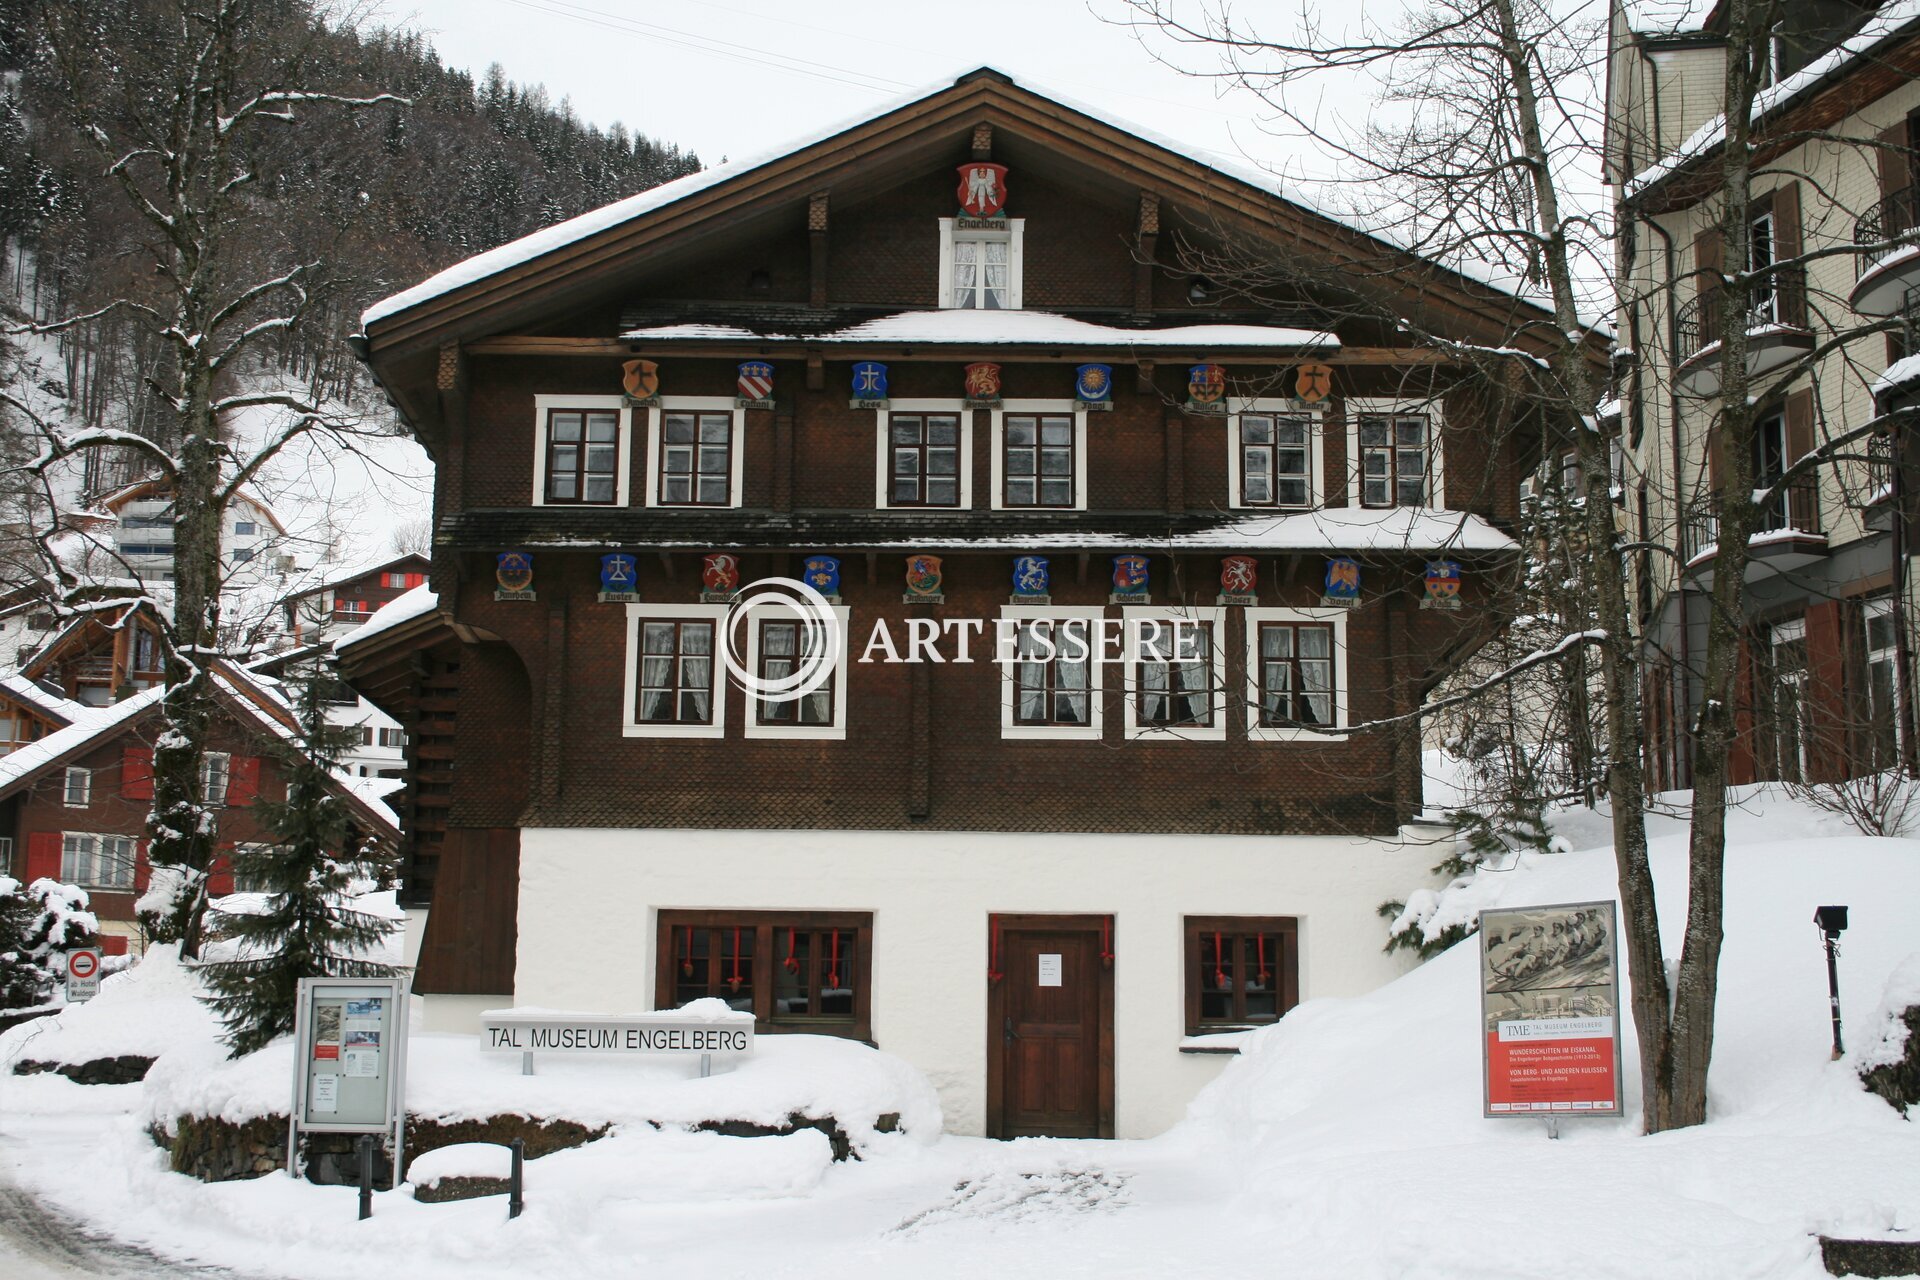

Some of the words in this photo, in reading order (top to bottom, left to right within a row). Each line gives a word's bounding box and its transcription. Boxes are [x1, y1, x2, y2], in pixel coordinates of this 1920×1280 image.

[958, 218, 1005, 229] Engelberg
[858, 400, 881, 409] Hess
[1506, 1025, 1530, 1036] TME
[489, 1028, 522, 1047] TAL
[531, 1029, 618, 1048] MUSEUM
[626, 1030, 747, 1050] ENGELBERG
